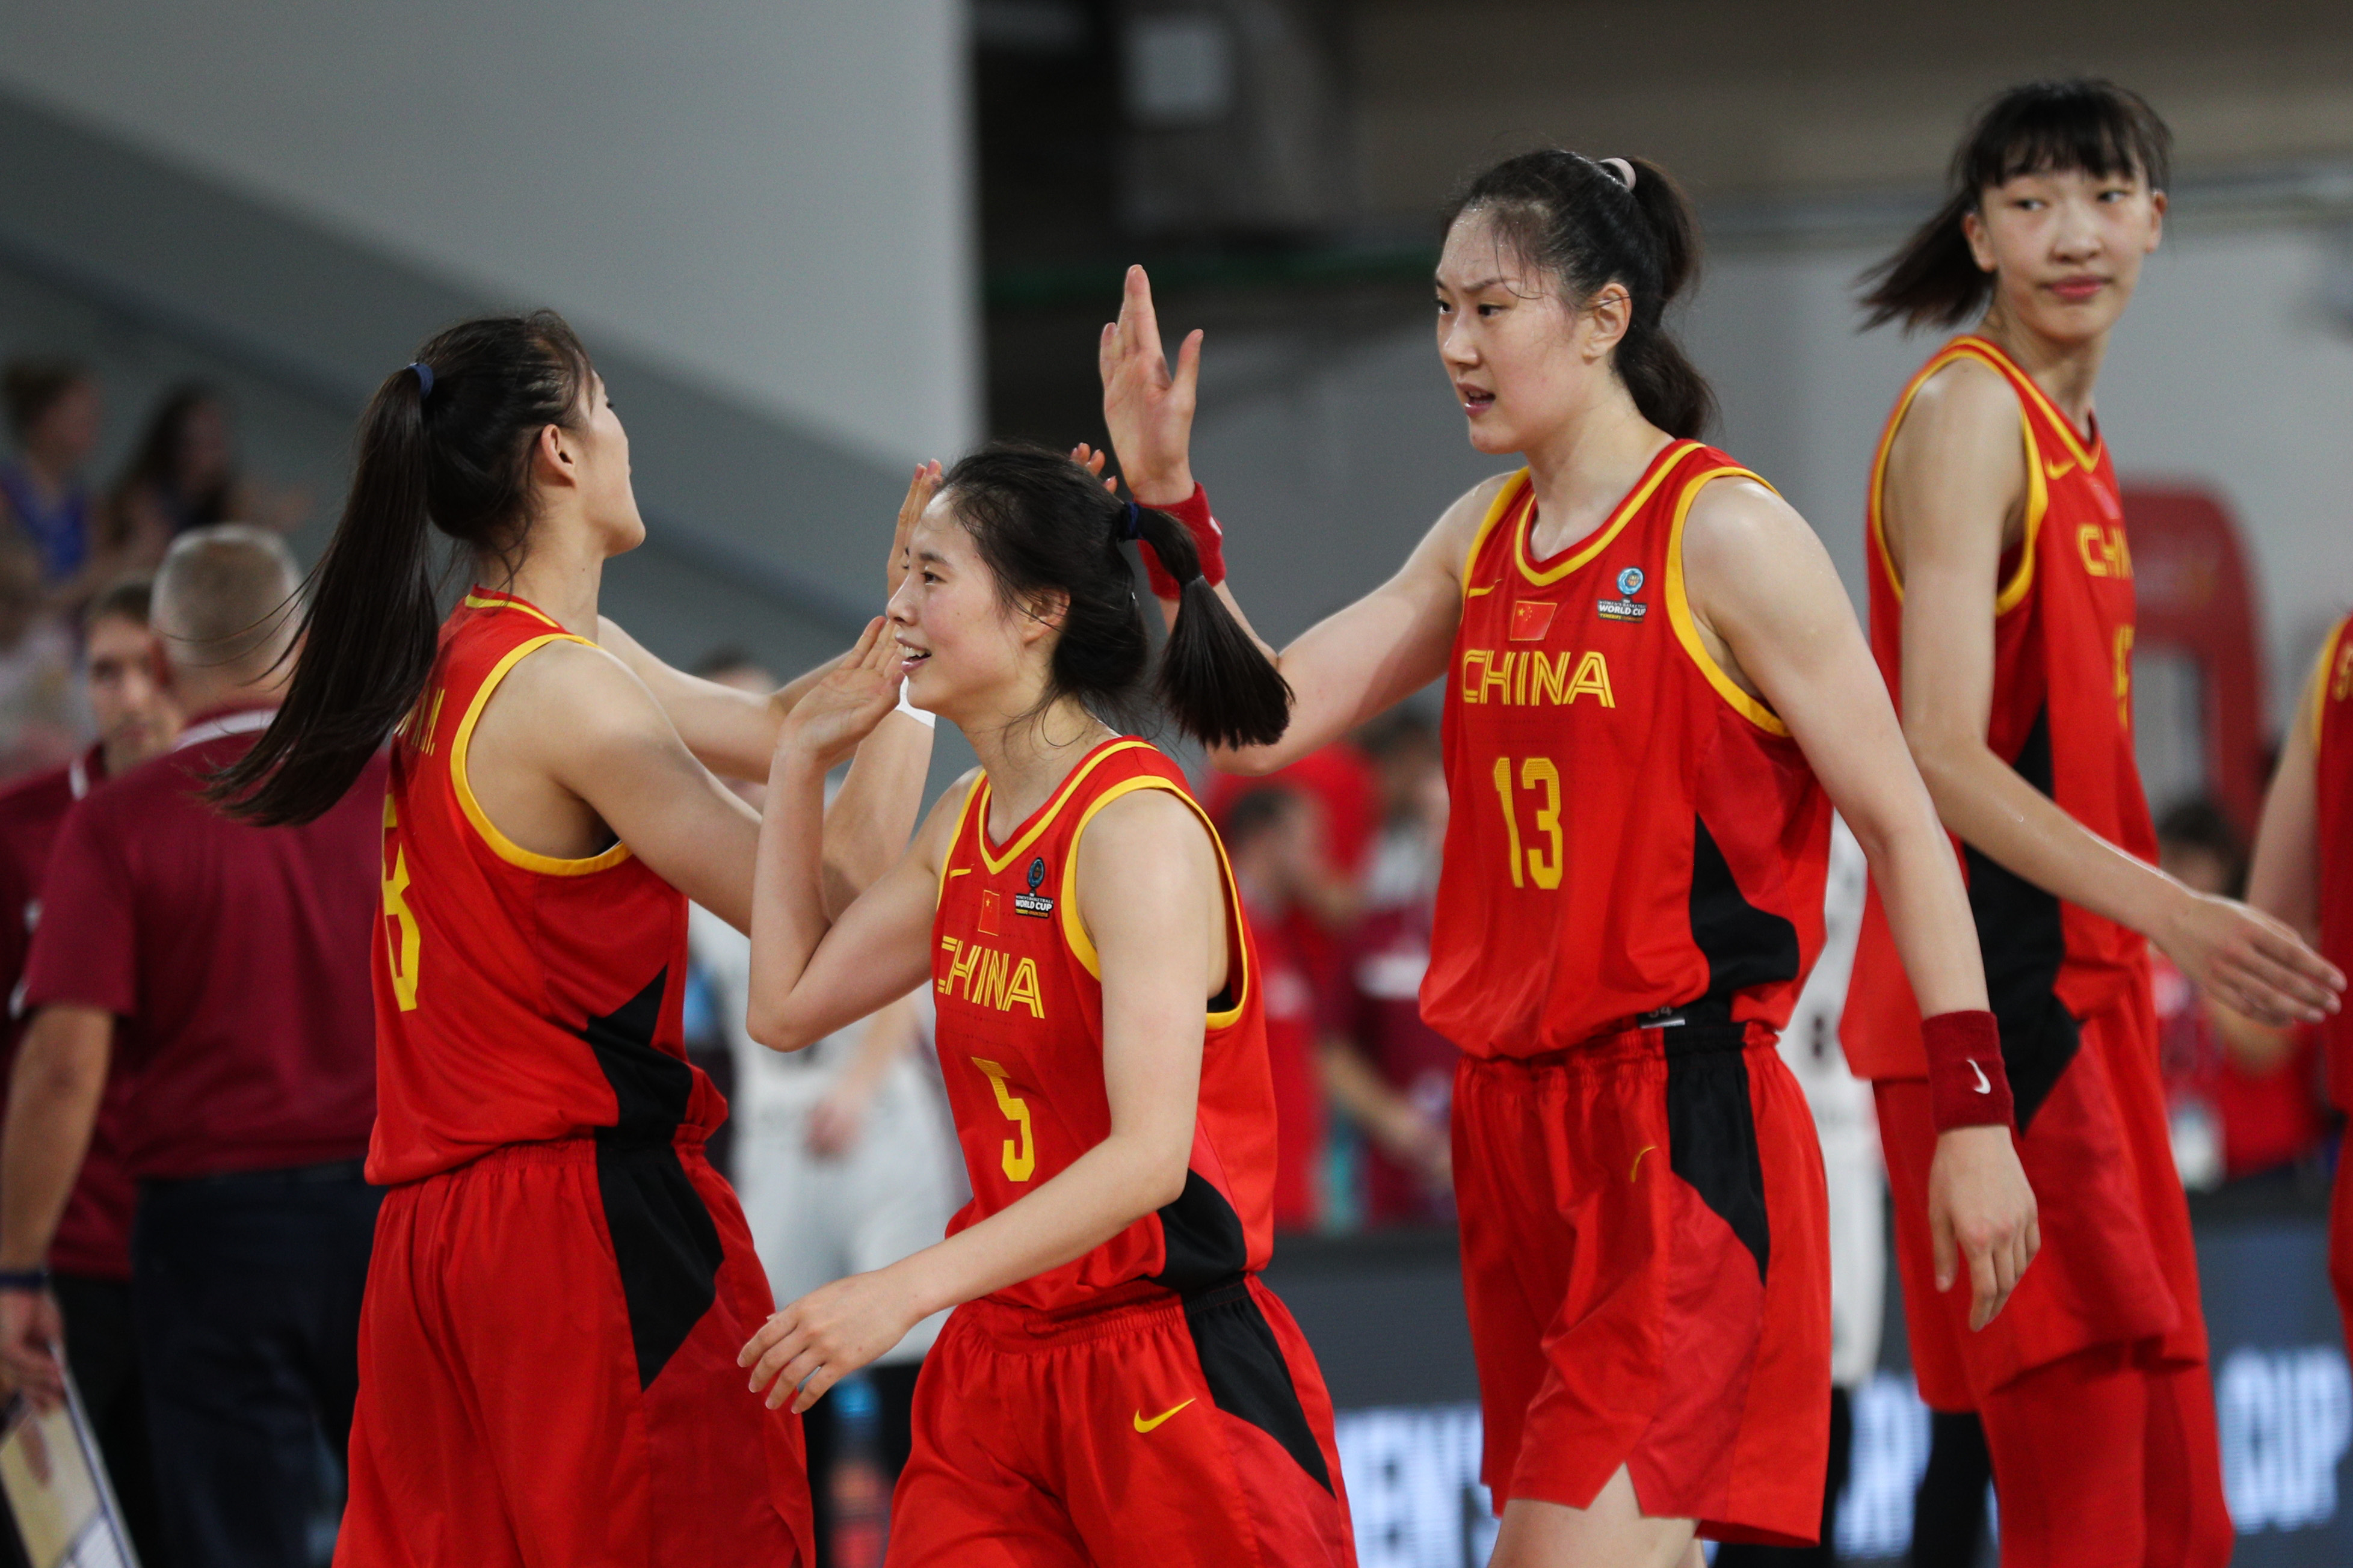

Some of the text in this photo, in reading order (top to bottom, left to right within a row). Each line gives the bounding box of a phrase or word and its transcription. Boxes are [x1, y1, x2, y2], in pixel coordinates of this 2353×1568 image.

[1599, 604, 1632, 615] WORLD
[1463, 648, 1615, 709] CHINA
[1493, 757, 1564, 889] 13
[1016, 899, 1052, 911] WORLD CUP
[970, 1057, 1035, 1182] 5
